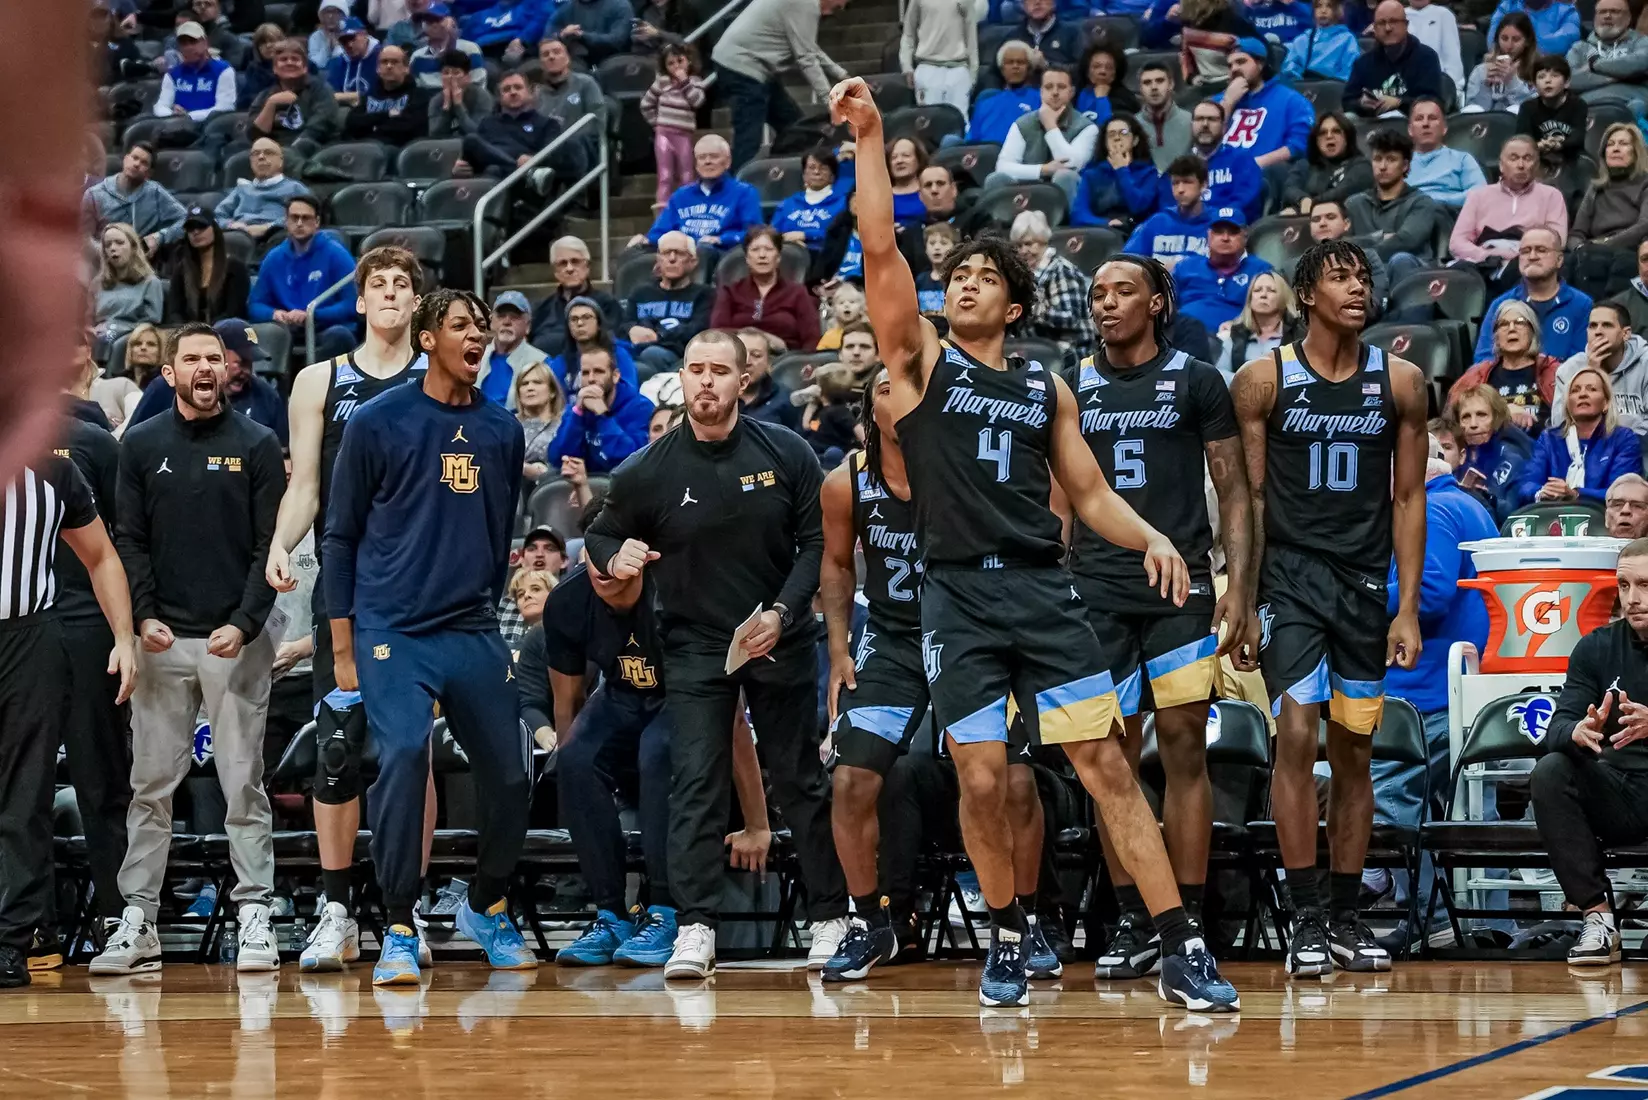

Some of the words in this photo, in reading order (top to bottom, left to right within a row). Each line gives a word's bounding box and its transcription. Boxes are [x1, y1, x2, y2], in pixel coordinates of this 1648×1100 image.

[1222, 106, 1267, 148] R
[942, 386, 1048, 429] Marquette
[1080, 404, 1181, 436] Marquette
[1282, 407, 1387, 439] Marquette
[207, 456, 222, 464] WE
[223, 457, 241, 466] ARE
[439, 453, 481, 494] MU
[976, 427, 1013, 483] 4
[1112, 438, 1148, 490] 5
[1307, 441, 1360, 492] 10
[739, 474, 756, 485] WE
[756, 470, 775, 482] ARE
[1521, 590, 1563, 635] G
[616, 655, 658, 689] MU
